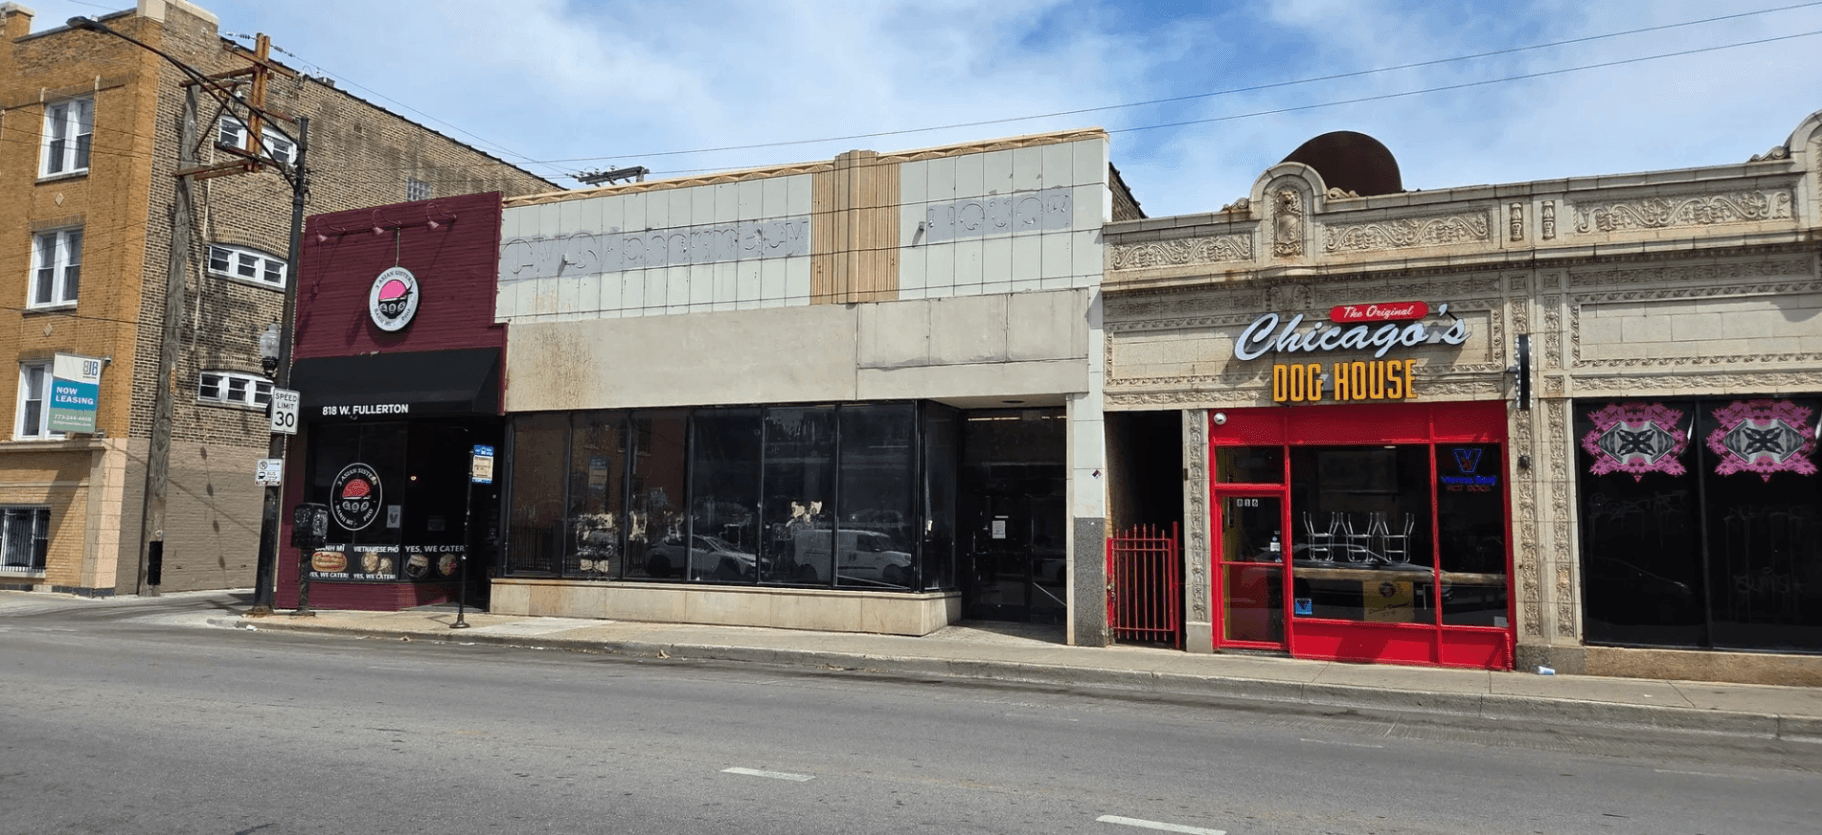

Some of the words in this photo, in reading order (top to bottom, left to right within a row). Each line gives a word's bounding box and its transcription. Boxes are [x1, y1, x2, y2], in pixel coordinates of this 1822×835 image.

[379, 271, 394, 284] ASIAN
[394, 270, 414, 284] SISTERS
[401, 308, 411, 321] PHO
[1343, 306, 1363, 318] The
[1365, 304, 1415, 320] Original
[1234, 303, 1472, 361] Chicago's
[1273, 362, 1324, 403] DOG
[1333, 358, 1419, 401] HOUSE
[56, 386, 78, 395] NOW
[55, 395, 94, 405] LEASING
[275, 393, 297, 402] SPEED
[277, 402, 294, 410] LIMIT
[322, 406, 337, 416] 818
[339, 405, 351, 415] W.
[353, 404, 409, 415] FULLERTON
[275, 411, 295, 427] 30
[341, 468, 357, 481] ASIAN
[1237, 499, 1259, 507] 816
[363, 508, 374, 521] PHO
[405, 545, 423, 553] YES,
